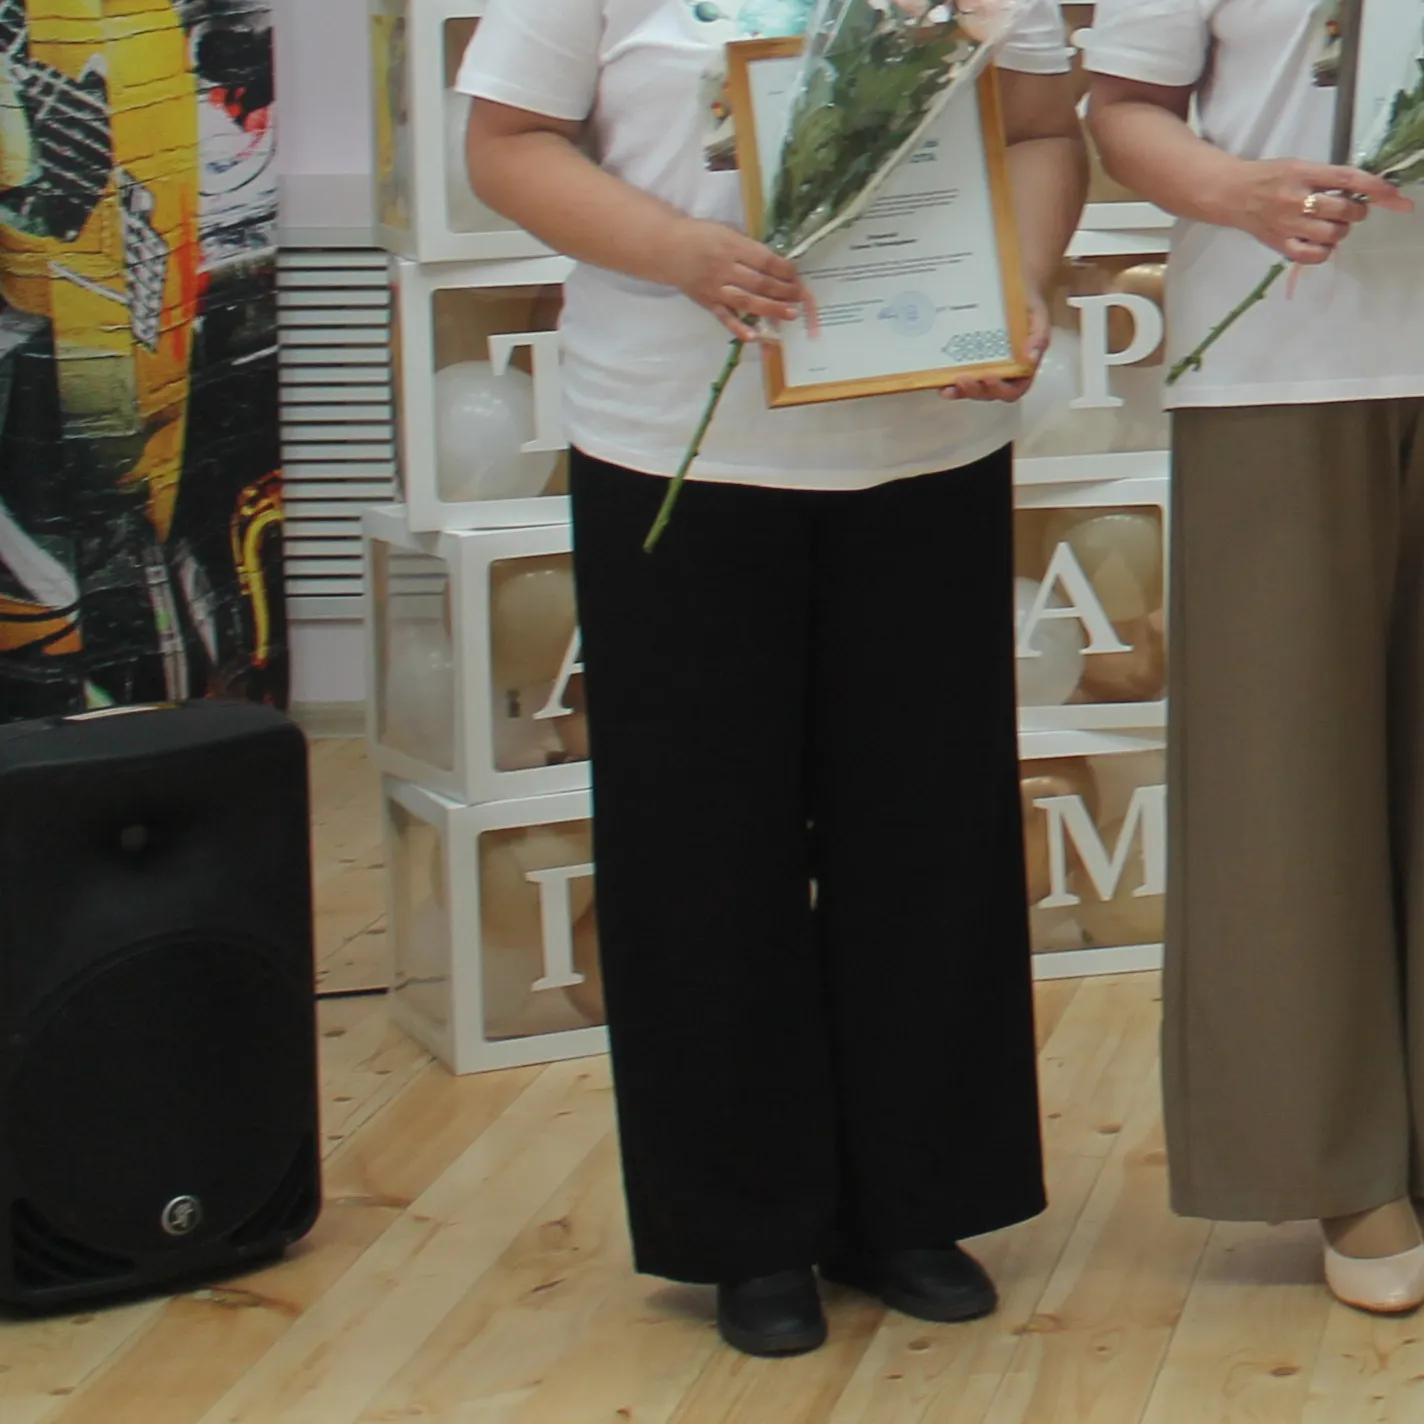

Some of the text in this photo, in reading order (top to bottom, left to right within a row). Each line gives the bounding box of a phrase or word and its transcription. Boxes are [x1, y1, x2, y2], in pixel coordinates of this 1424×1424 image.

[1068, 294, 1164, 410] Р
[1016, 541, 1133, 658] А
[1034, 784, 1167, 909] М
